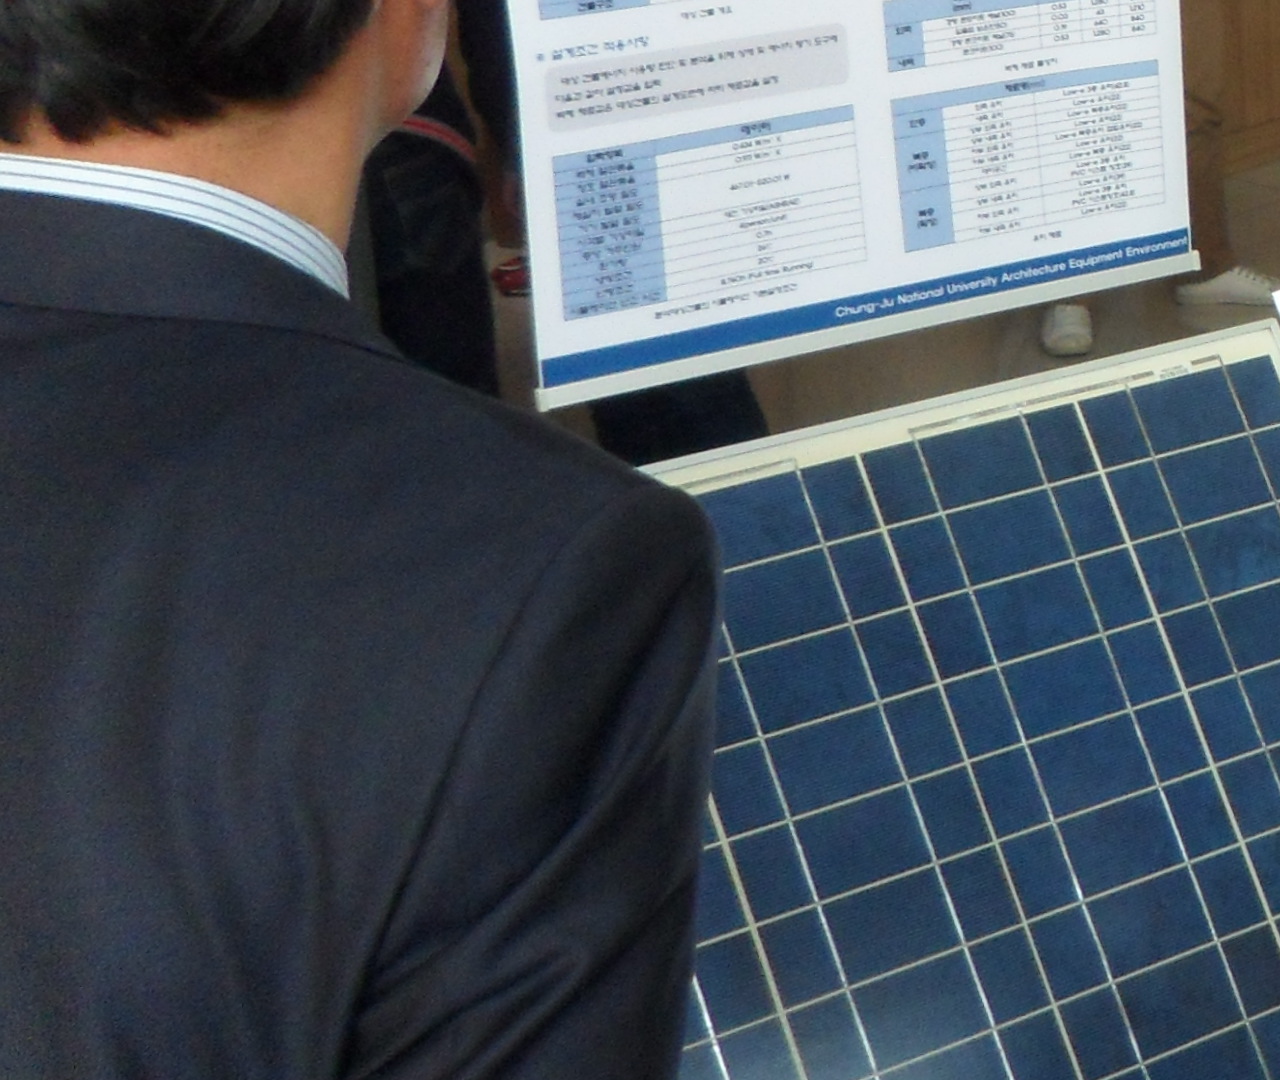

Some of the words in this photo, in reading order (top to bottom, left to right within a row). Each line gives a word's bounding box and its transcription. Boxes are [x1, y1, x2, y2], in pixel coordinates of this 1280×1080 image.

[834, 296, 895, 318] Chung-Ju
[896, 285, 945, 305] National
[946, 275, 999, 296] University
[1001, 261, 1067, 283] Architecture
[1068, 249, 1124, 271] Equipment
[1125, 235, 1188, 257] Environment
